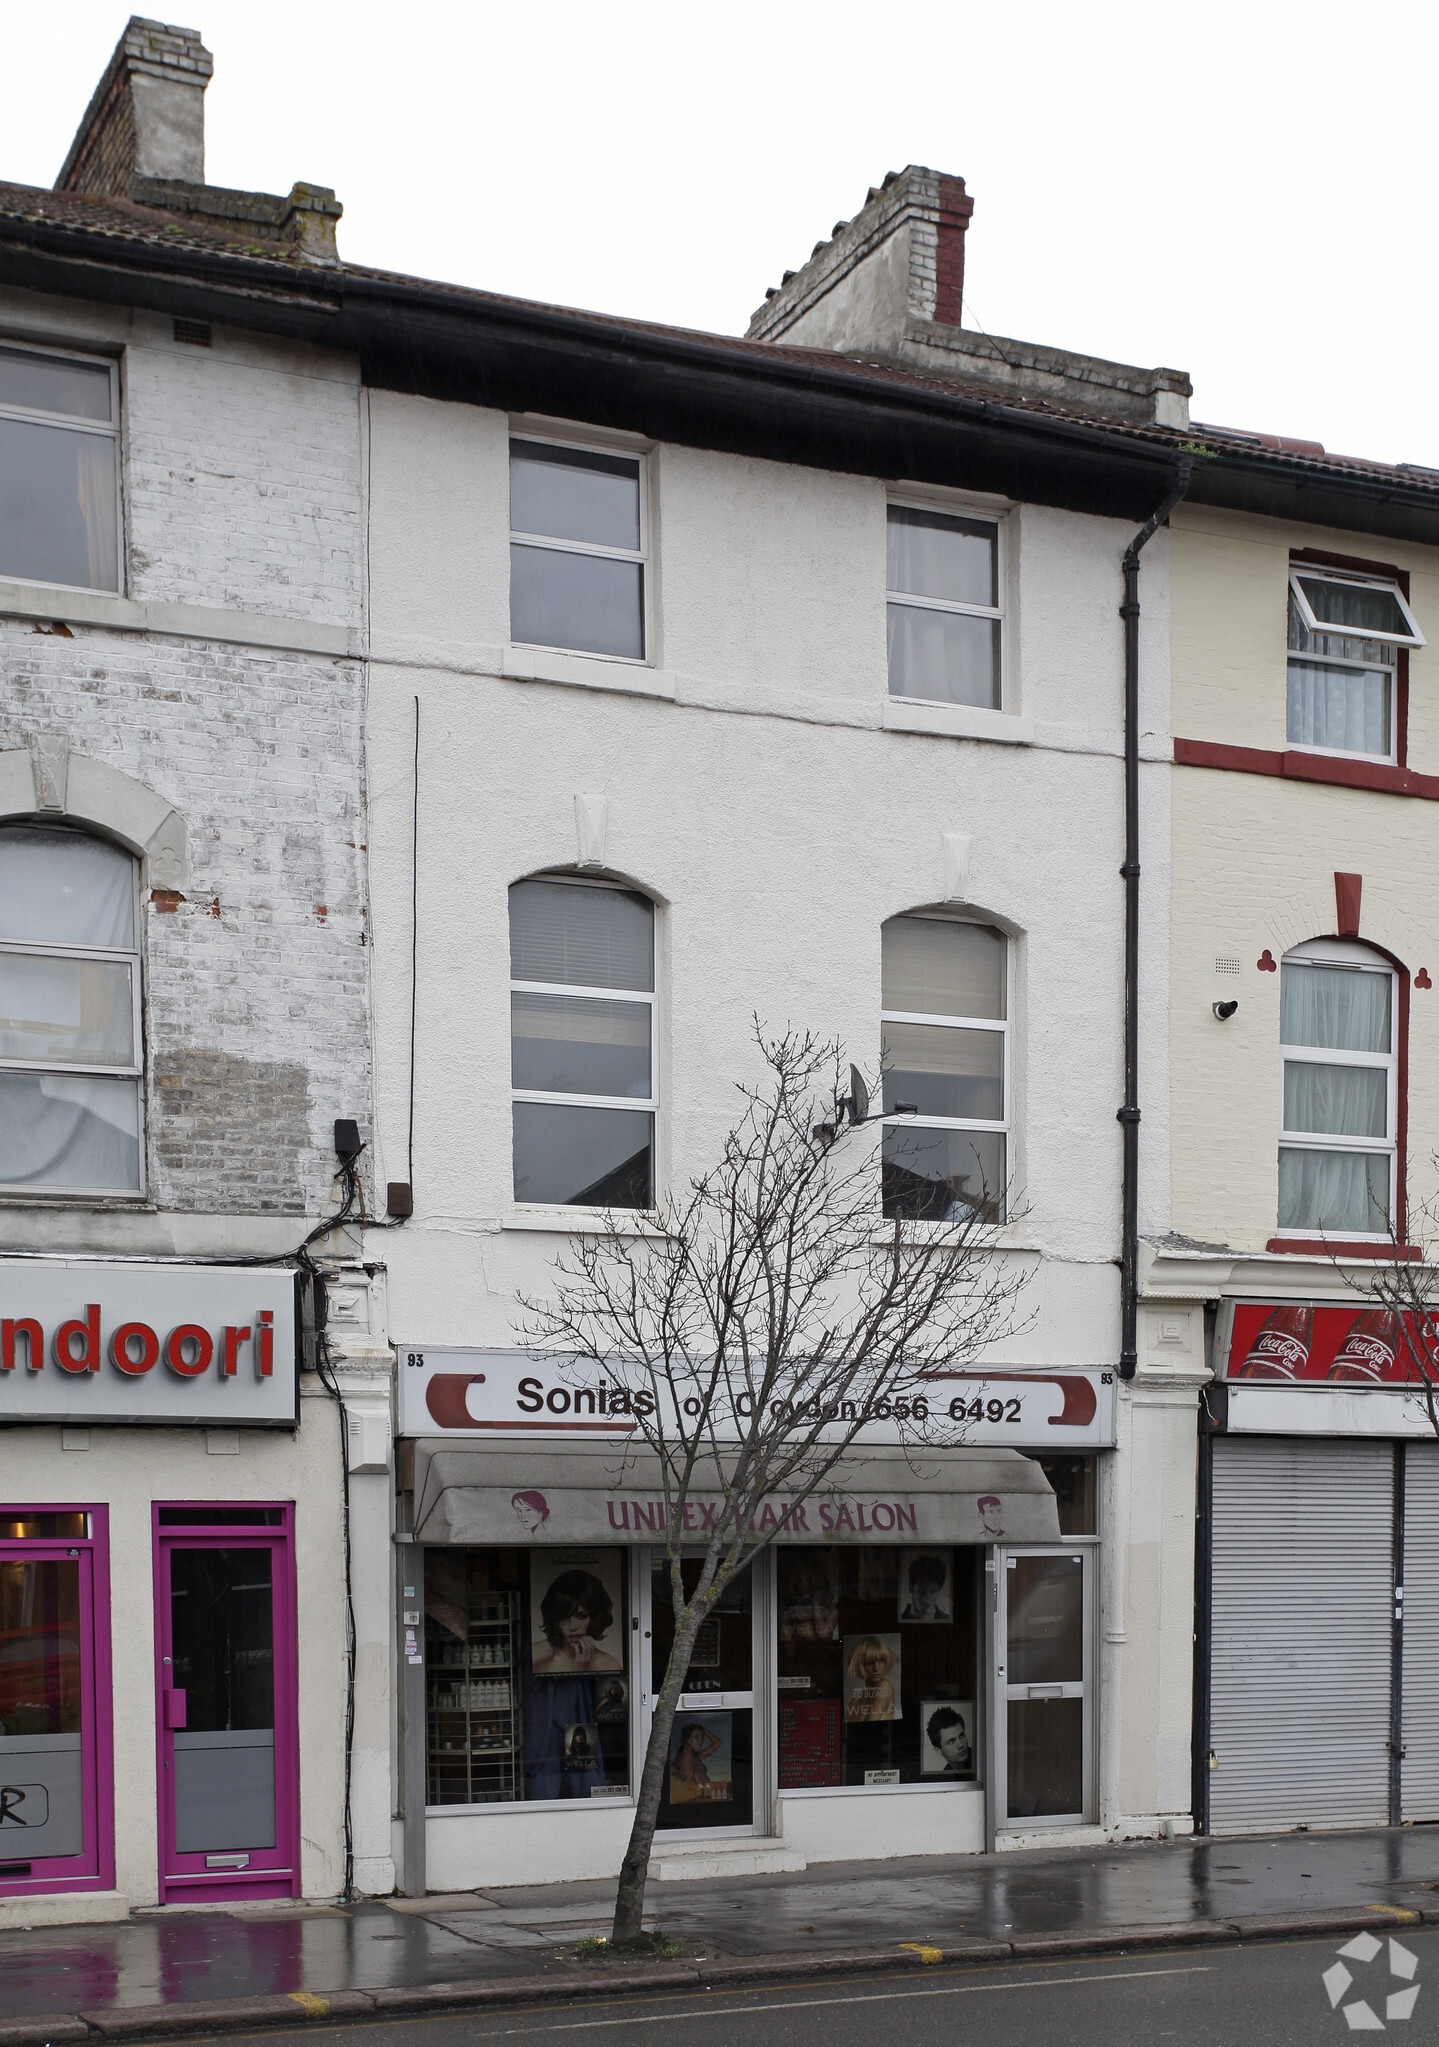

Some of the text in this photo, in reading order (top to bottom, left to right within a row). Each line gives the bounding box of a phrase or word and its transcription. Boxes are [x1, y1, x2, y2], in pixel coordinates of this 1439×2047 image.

[0, 1303, 274, 1377] ndoori
[407, 1353, 424, 1367] 93
[1101, 1372, 1113, 1385] 93
[516, 1377, 655, 1416] Sonias
[684, 1391, 713, 1416] o
[876, 1396, 929, 1420] 656
[950, 1397, 1022, 1423] 6492
[606, 1501, 717, 1531] UNIEX
[818, 1503, 917, 1531] SALON
[689, 1679, 721, 1691] OPEN
[847, 1704, 898, 1716] WELLA
[566, 1759, 597, 1768] WELLA
